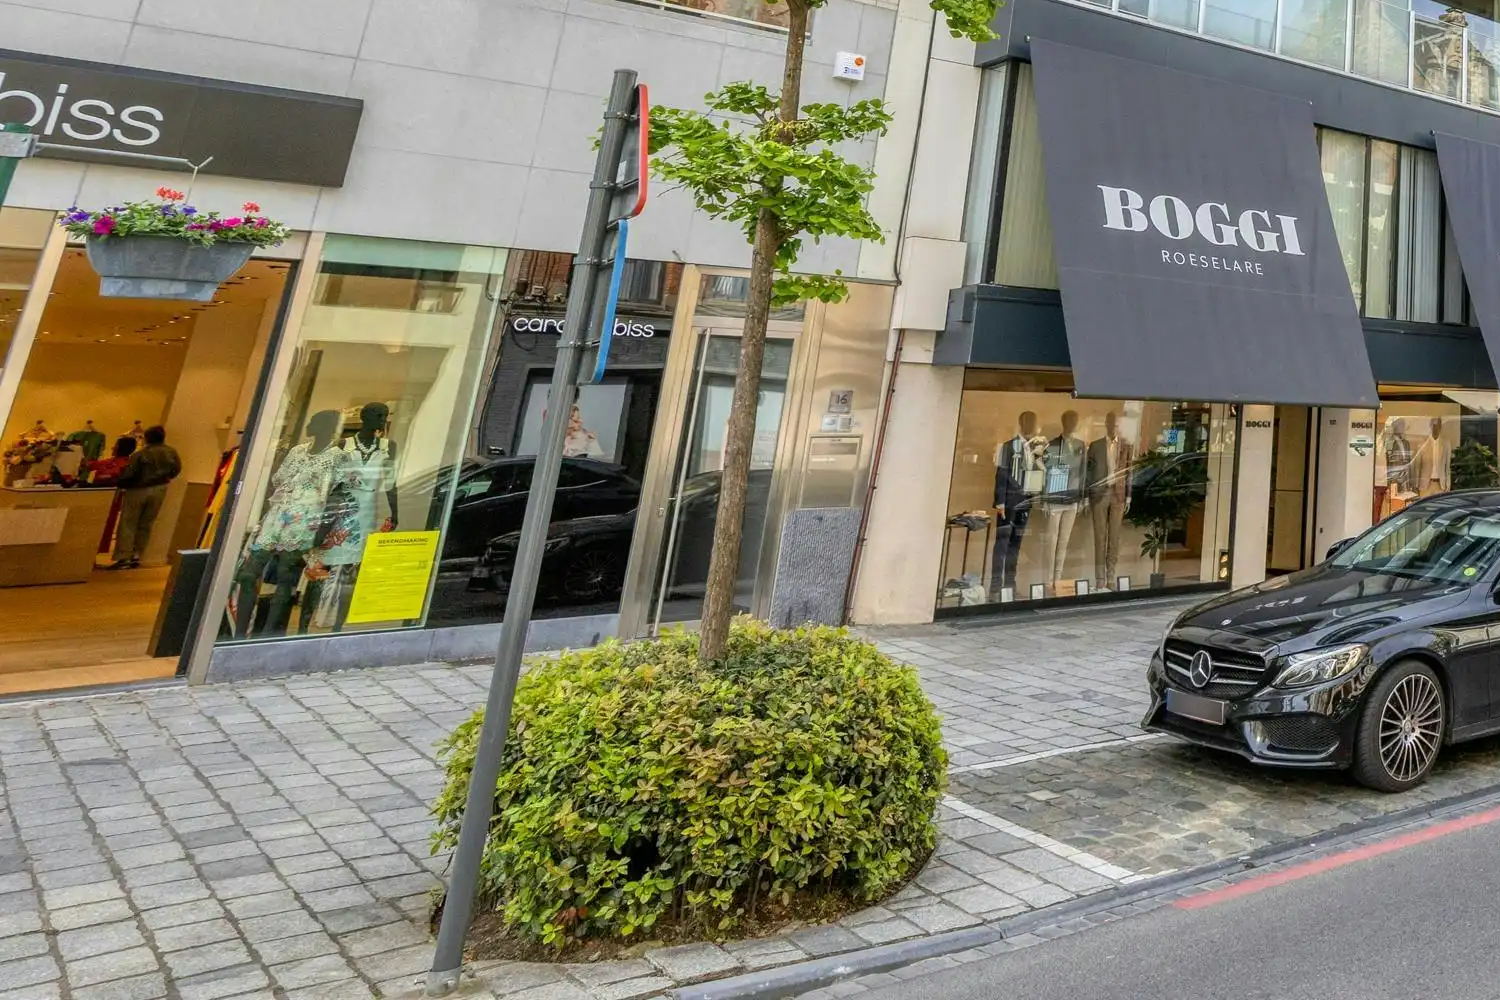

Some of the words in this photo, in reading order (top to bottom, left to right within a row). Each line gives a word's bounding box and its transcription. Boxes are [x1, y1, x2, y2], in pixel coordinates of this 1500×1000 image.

[1097, 184, 1305, 256] BOGGI
[1161, 249, 1264, 276] ROESELARE
[613, 318, 655, 338] biss
